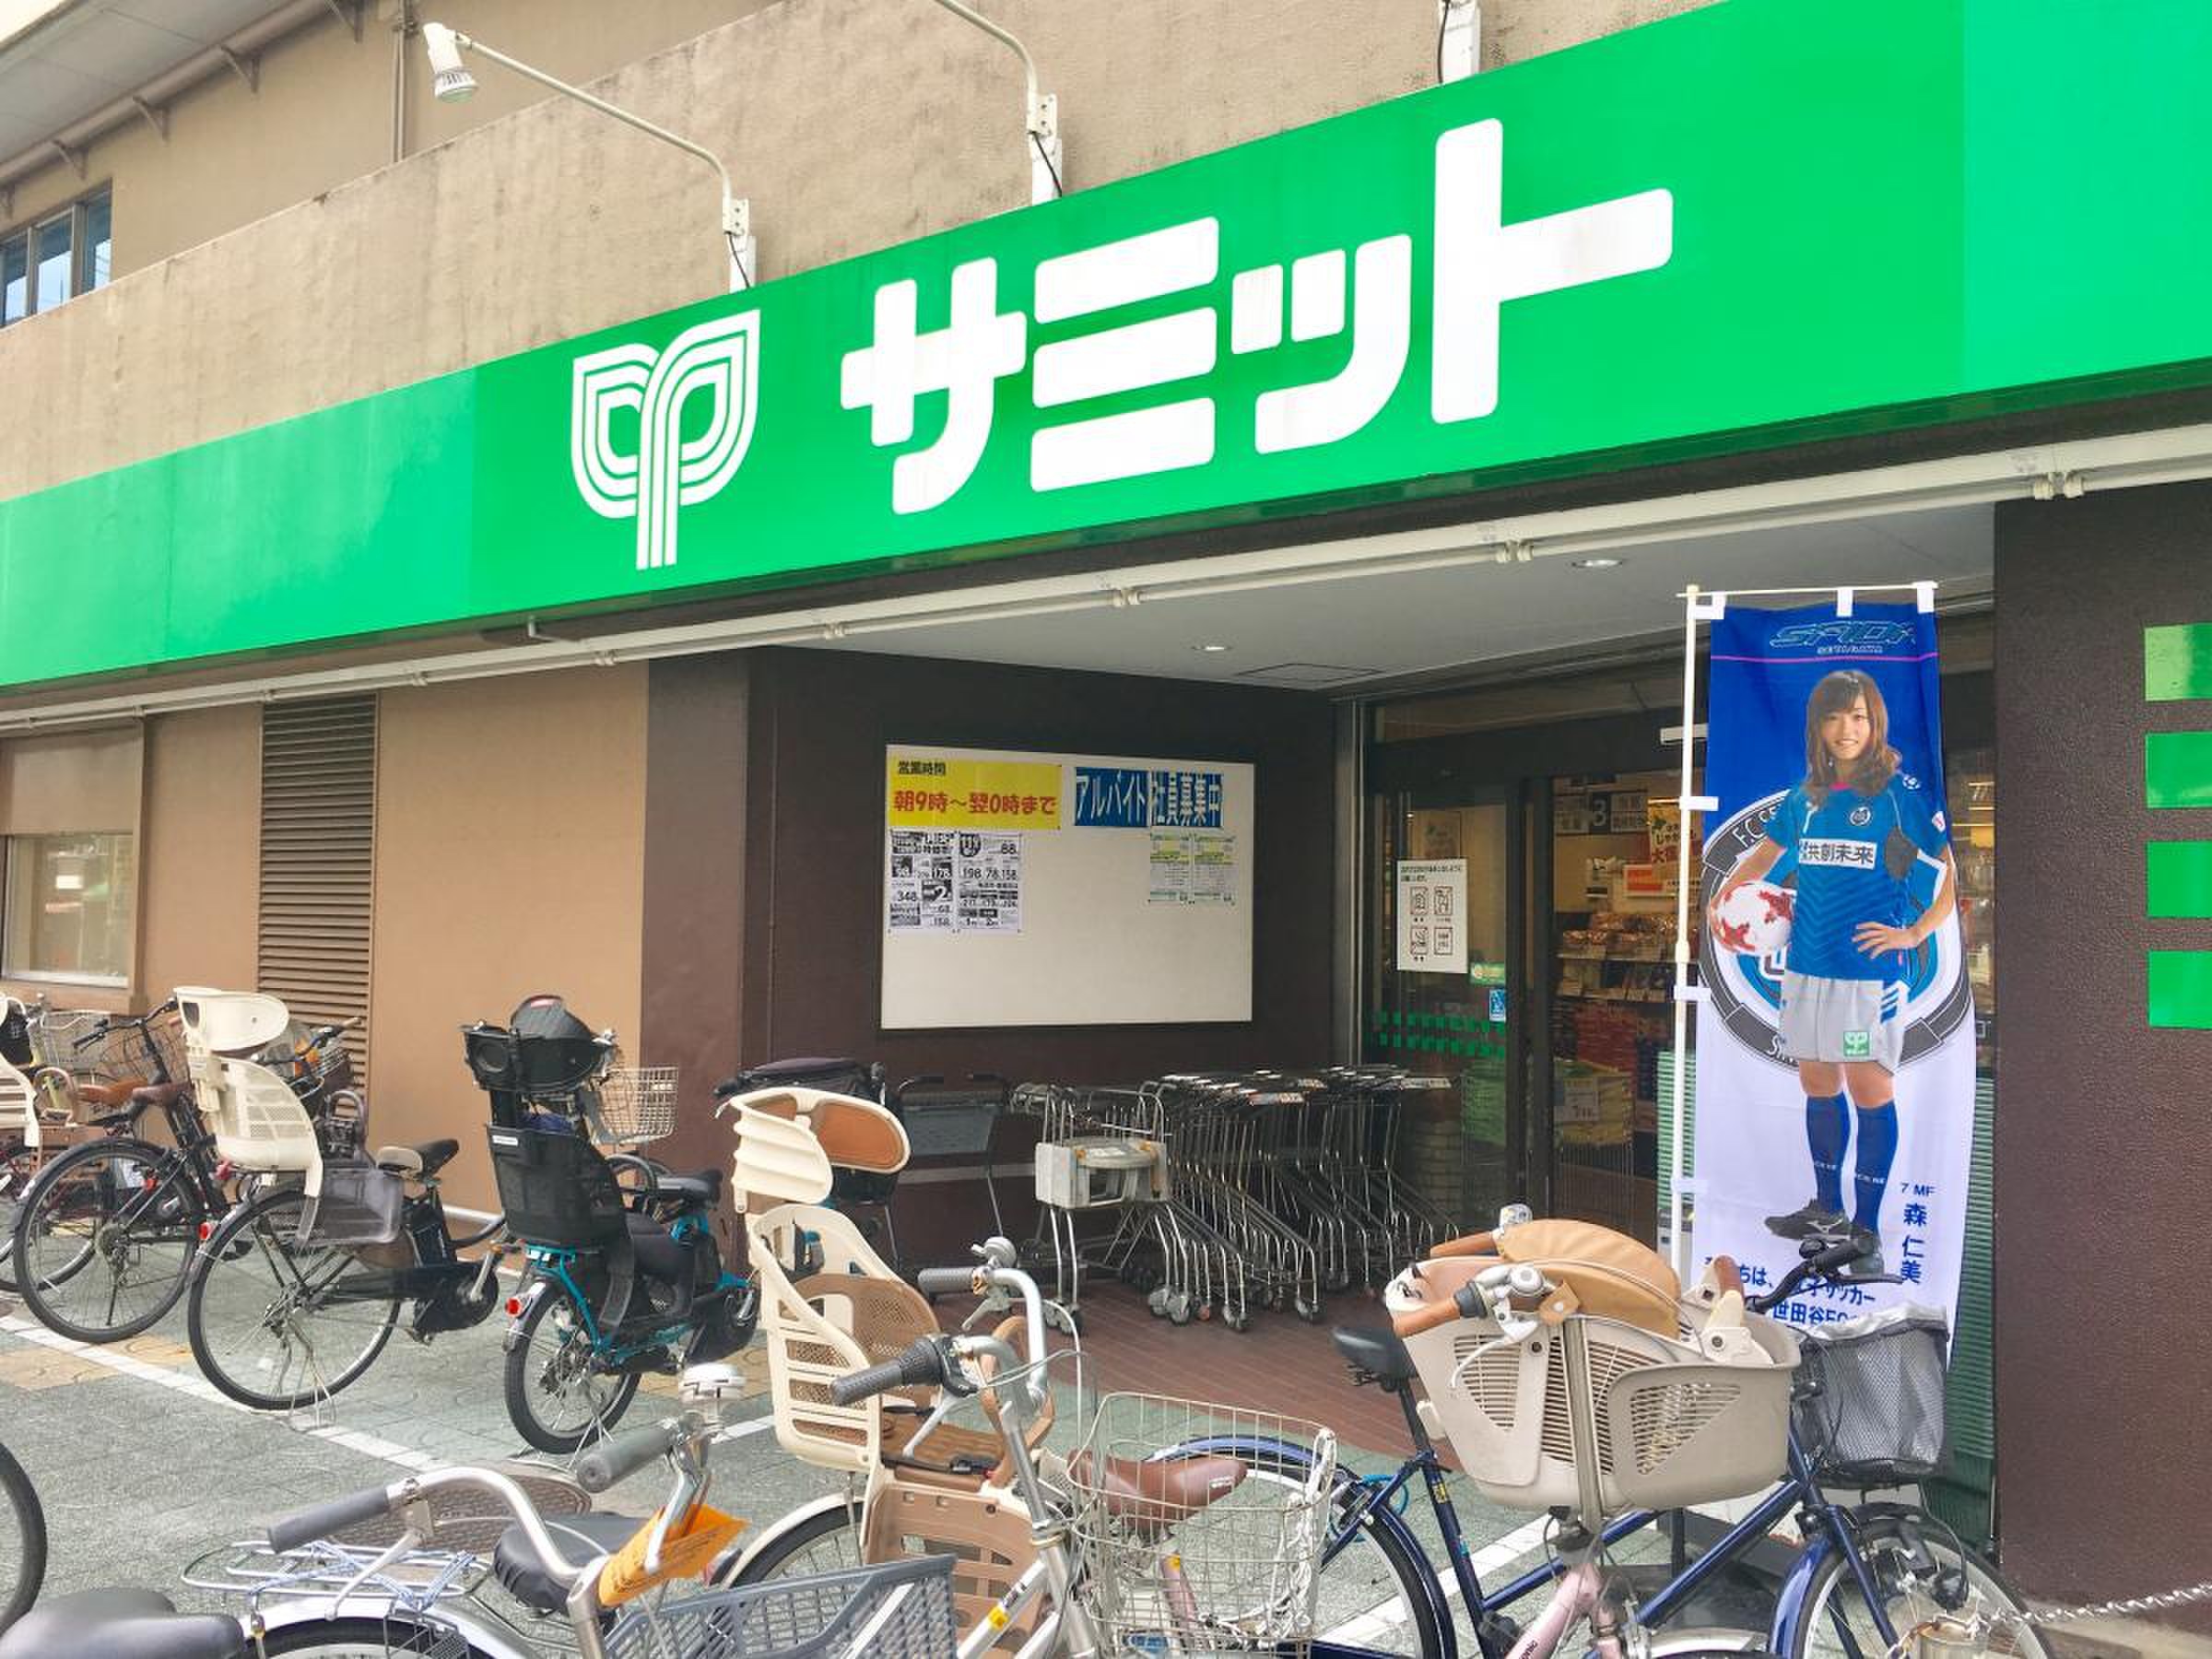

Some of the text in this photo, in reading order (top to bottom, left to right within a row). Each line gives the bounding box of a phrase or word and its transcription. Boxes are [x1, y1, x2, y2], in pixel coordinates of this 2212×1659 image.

[841, 118, 1674, 514] サミット
[899, 761, 947, 775] 営業時間
[1076, 769, 1146, 824] アルバイト
[1900, 1182, 1936, 1197] 7 MF
